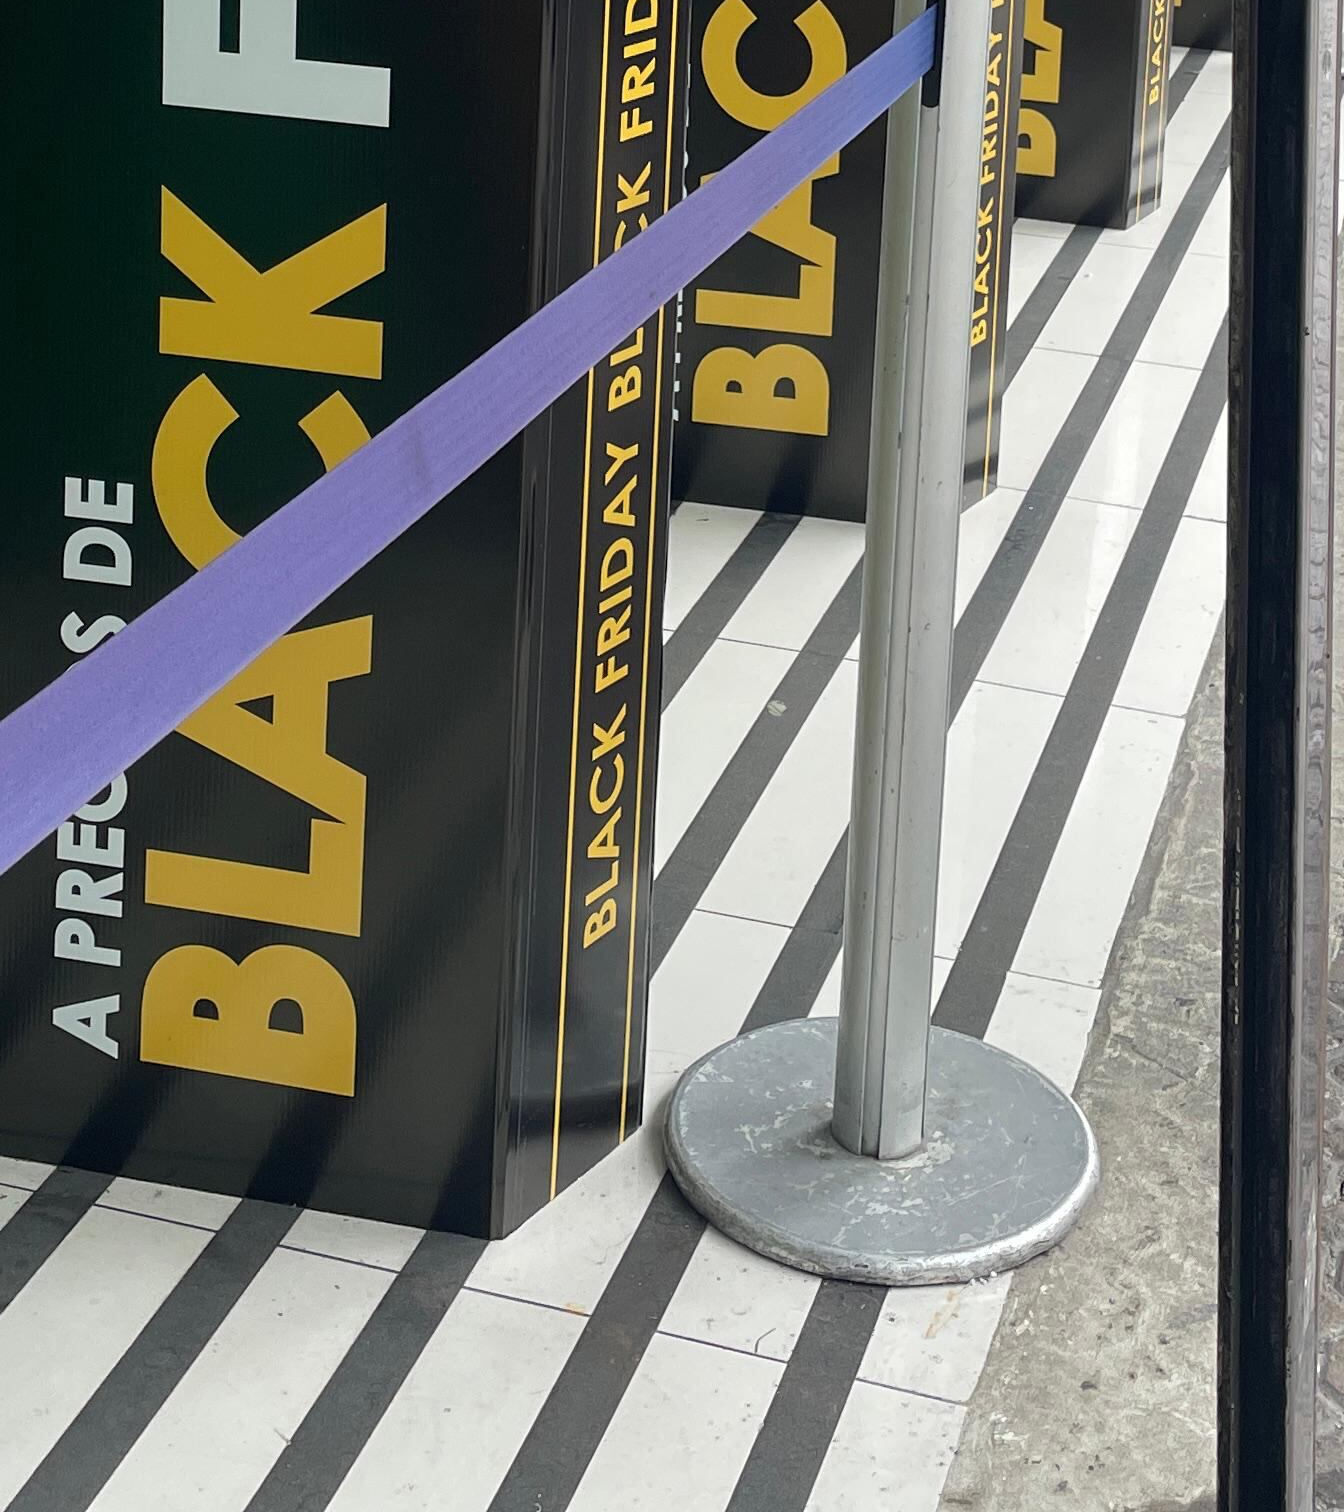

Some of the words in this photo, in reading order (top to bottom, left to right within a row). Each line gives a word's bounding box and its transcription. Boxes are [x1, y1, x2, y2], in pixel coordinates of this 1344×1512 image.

[61, 476, 135, 586] DE
[594, 441, 640, 694] FRIDAY
[583, 705, 629, 949] BLACK
[52, 993, 121, 1059] A
